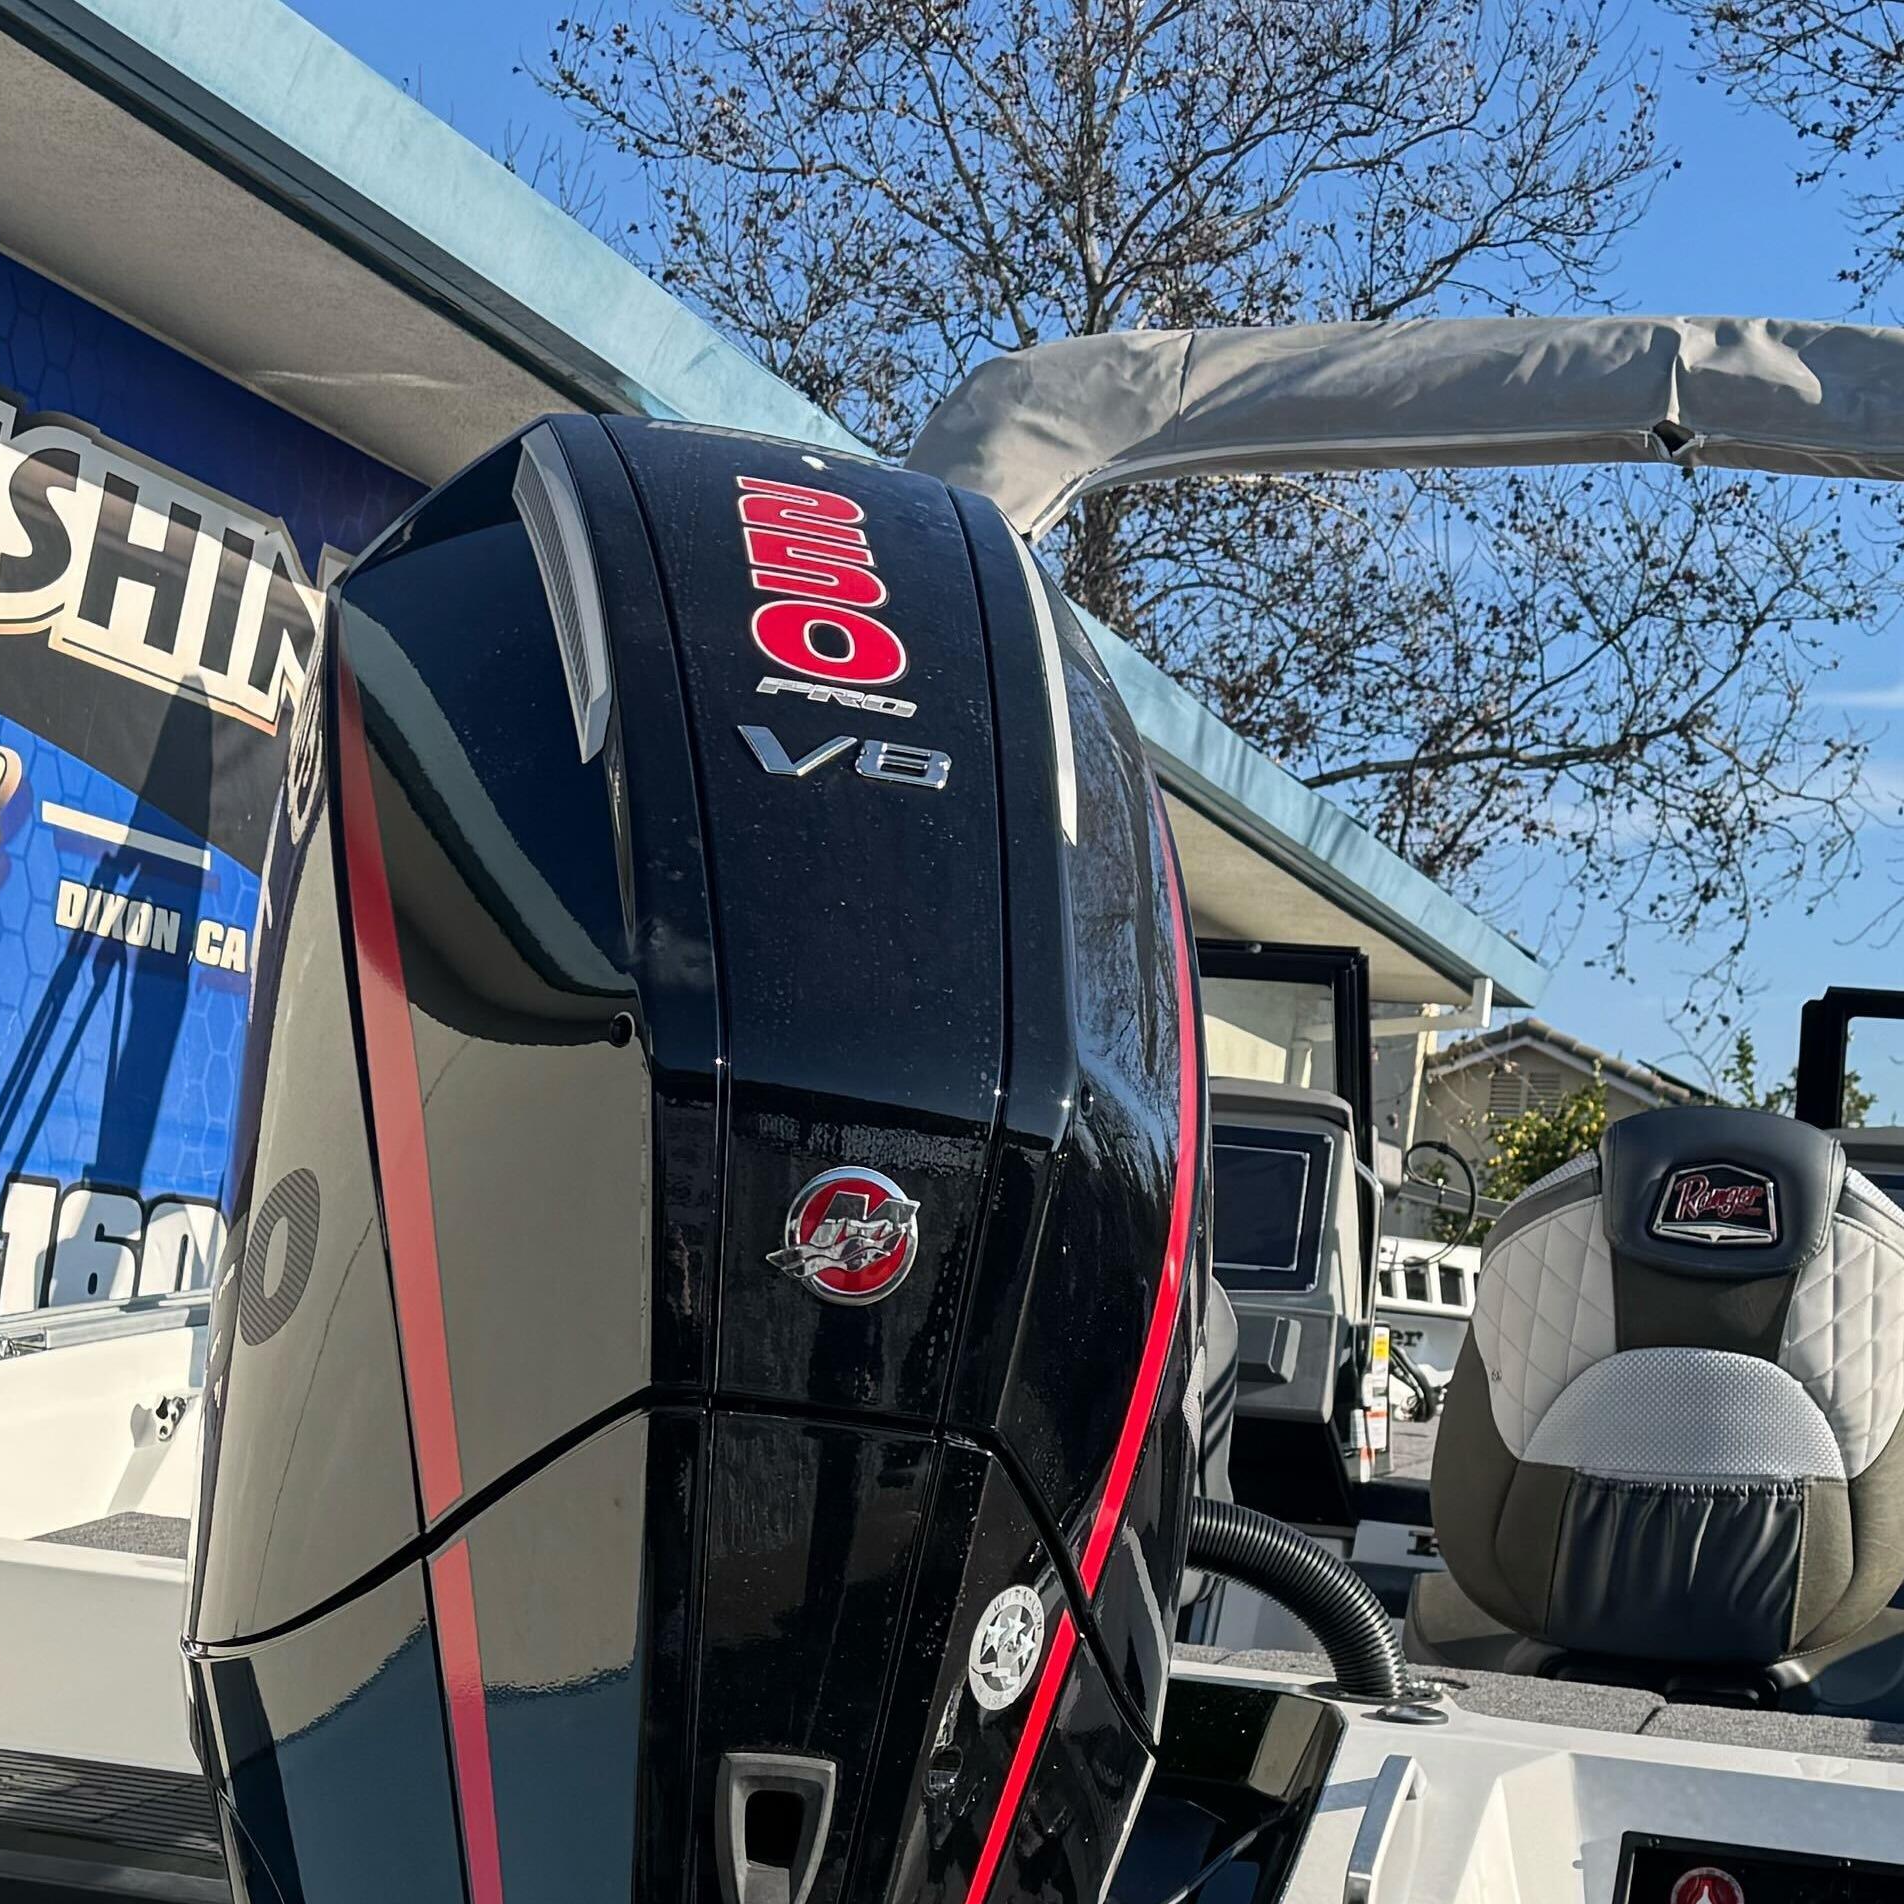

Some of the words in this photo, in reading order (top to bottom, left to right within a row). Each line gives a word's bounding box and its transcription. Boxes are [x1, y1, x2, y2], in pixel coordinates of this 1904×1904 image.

[736, 474, 908, 687] 250
[756, 676, 918, 718] PRO
[737, 724, 952, 790] V8
[54, 878, 182, 956] DIXON
[1675, 1173, 1765, 1219] Ranger
